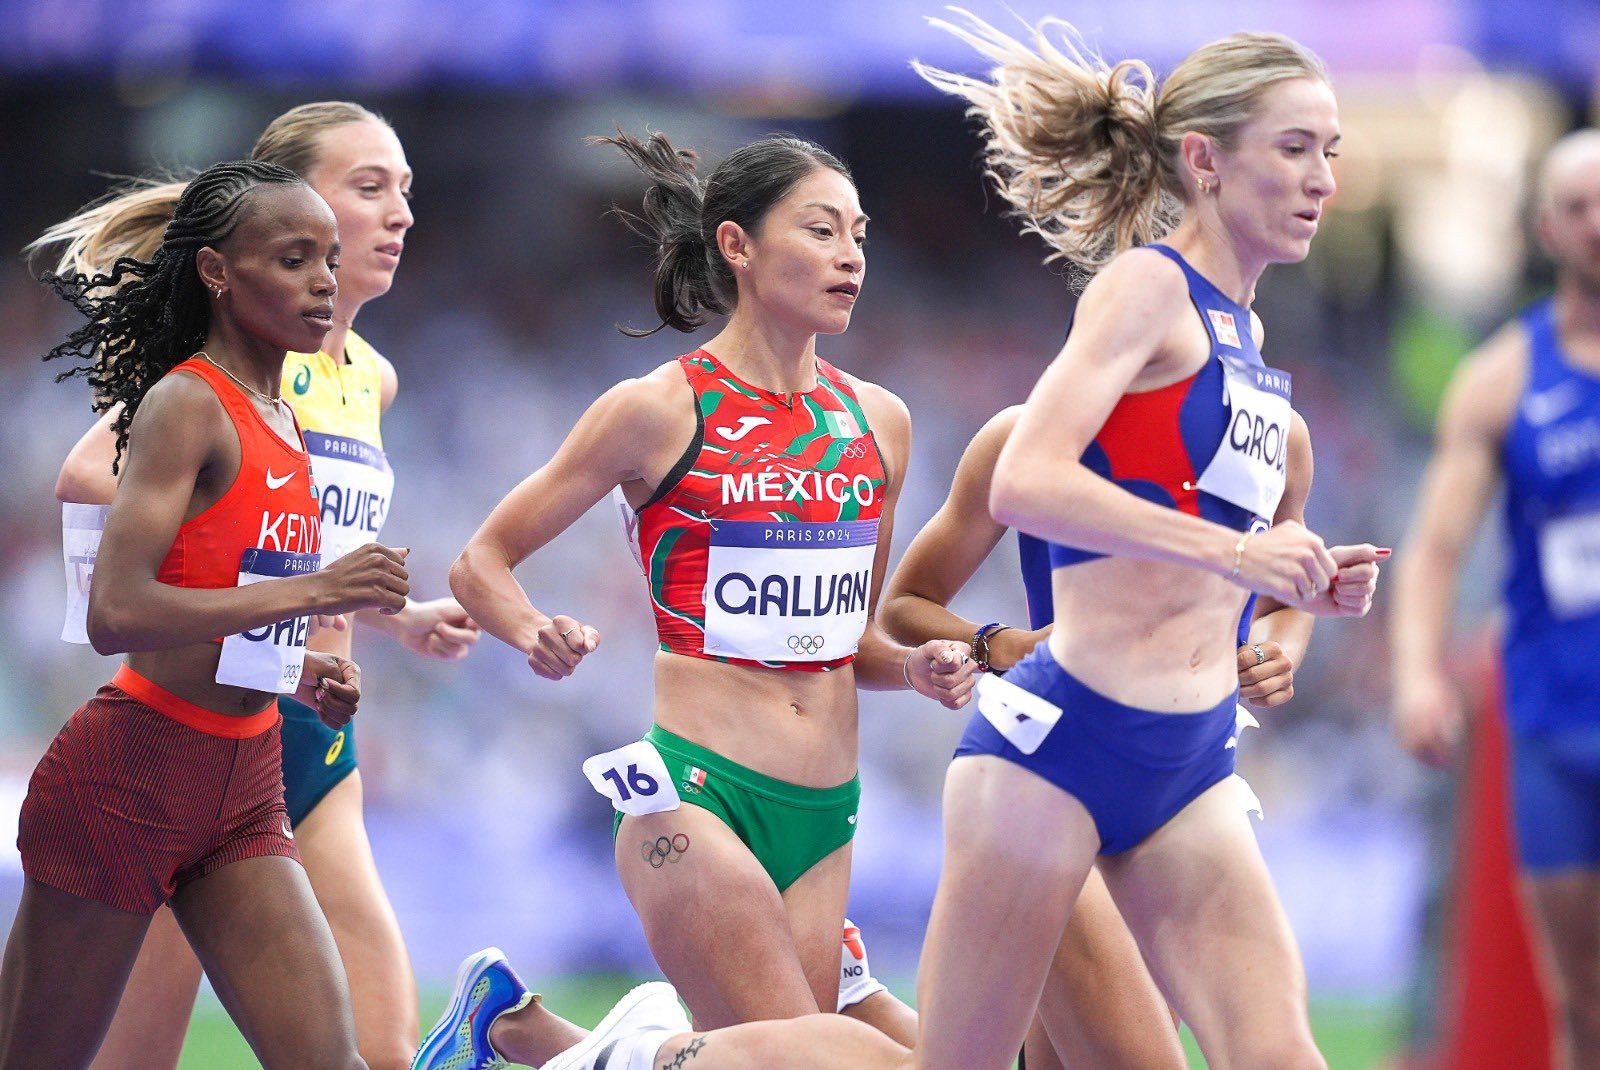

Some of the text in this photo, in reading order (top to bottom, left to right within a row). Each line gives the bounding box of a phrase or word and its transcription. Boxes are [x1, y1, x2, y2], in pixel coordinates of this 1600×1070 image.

[1256, 371, 1290, 394] PARIS
[324, 439, 358, 457] PARIS
[721, 465, 874, 507] MÉXICO
[765, 528, 850, 541] PARIS 2024
[284, 558, 310, 571] PARIS
[714, 569, 869, 616] GALVAN
[602, 763, 659, 801] 16
[843, 965, 863, 978] NO
